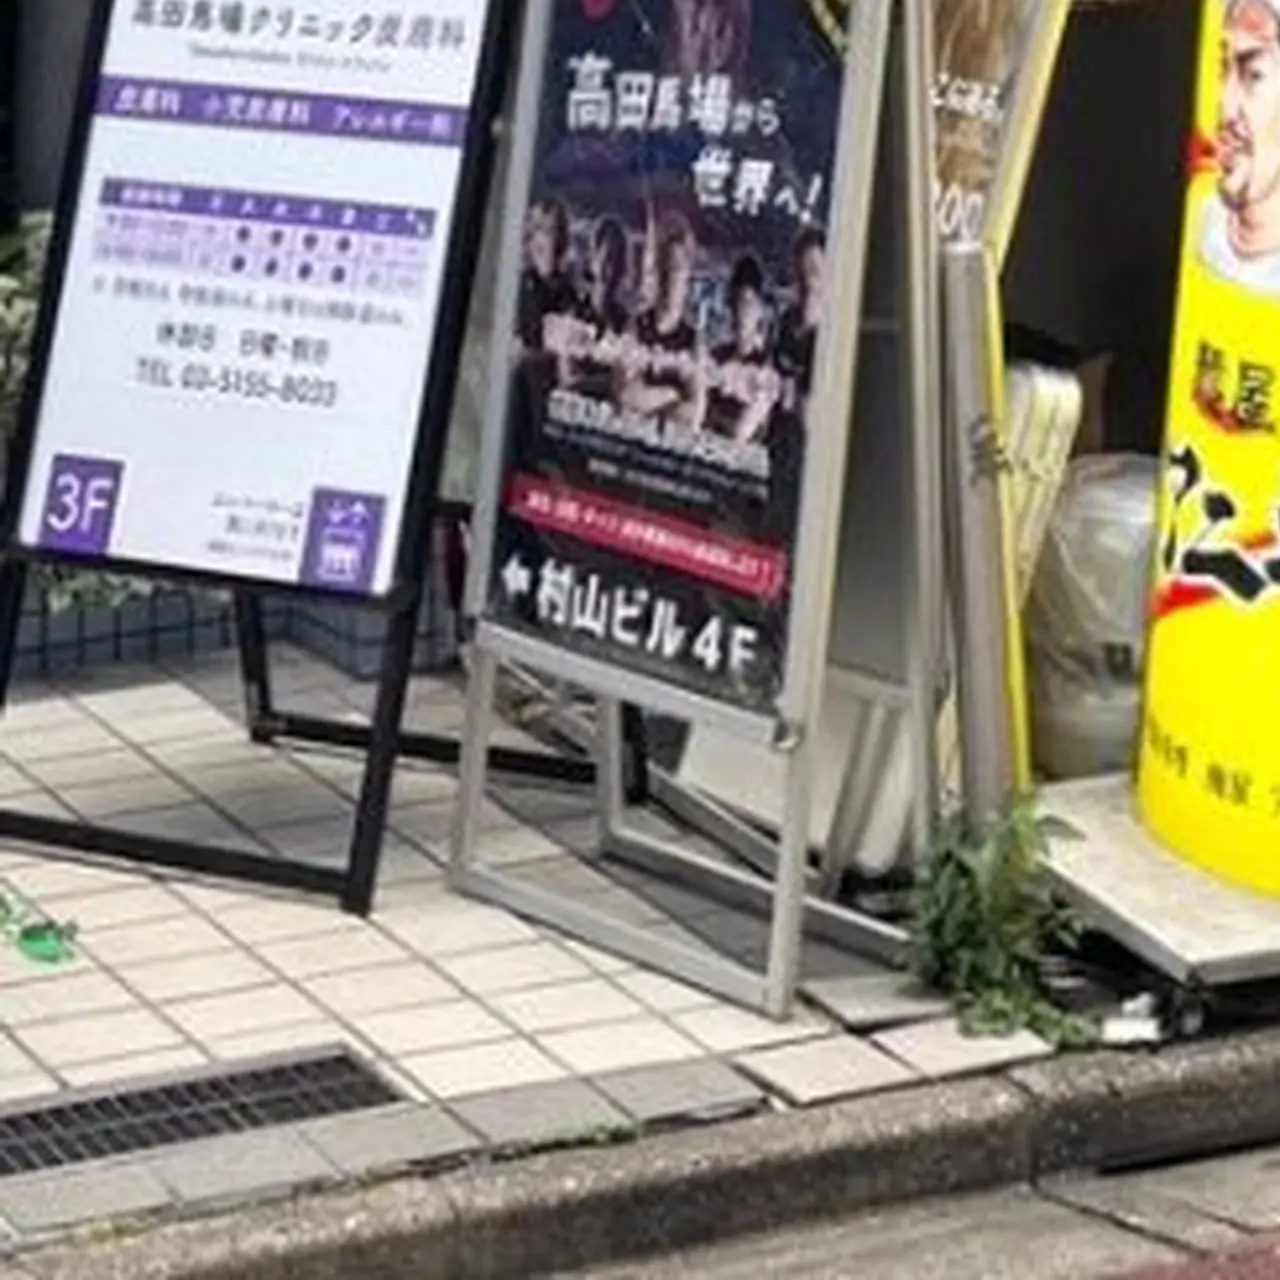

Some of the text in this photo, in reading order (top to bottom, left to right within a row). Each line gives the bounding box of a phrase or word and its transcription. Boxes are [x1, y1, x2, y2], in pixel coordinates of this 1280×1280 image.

[566, 50, 781, 137] 高田馬場から
[47, 473, 114, 532] 3F
